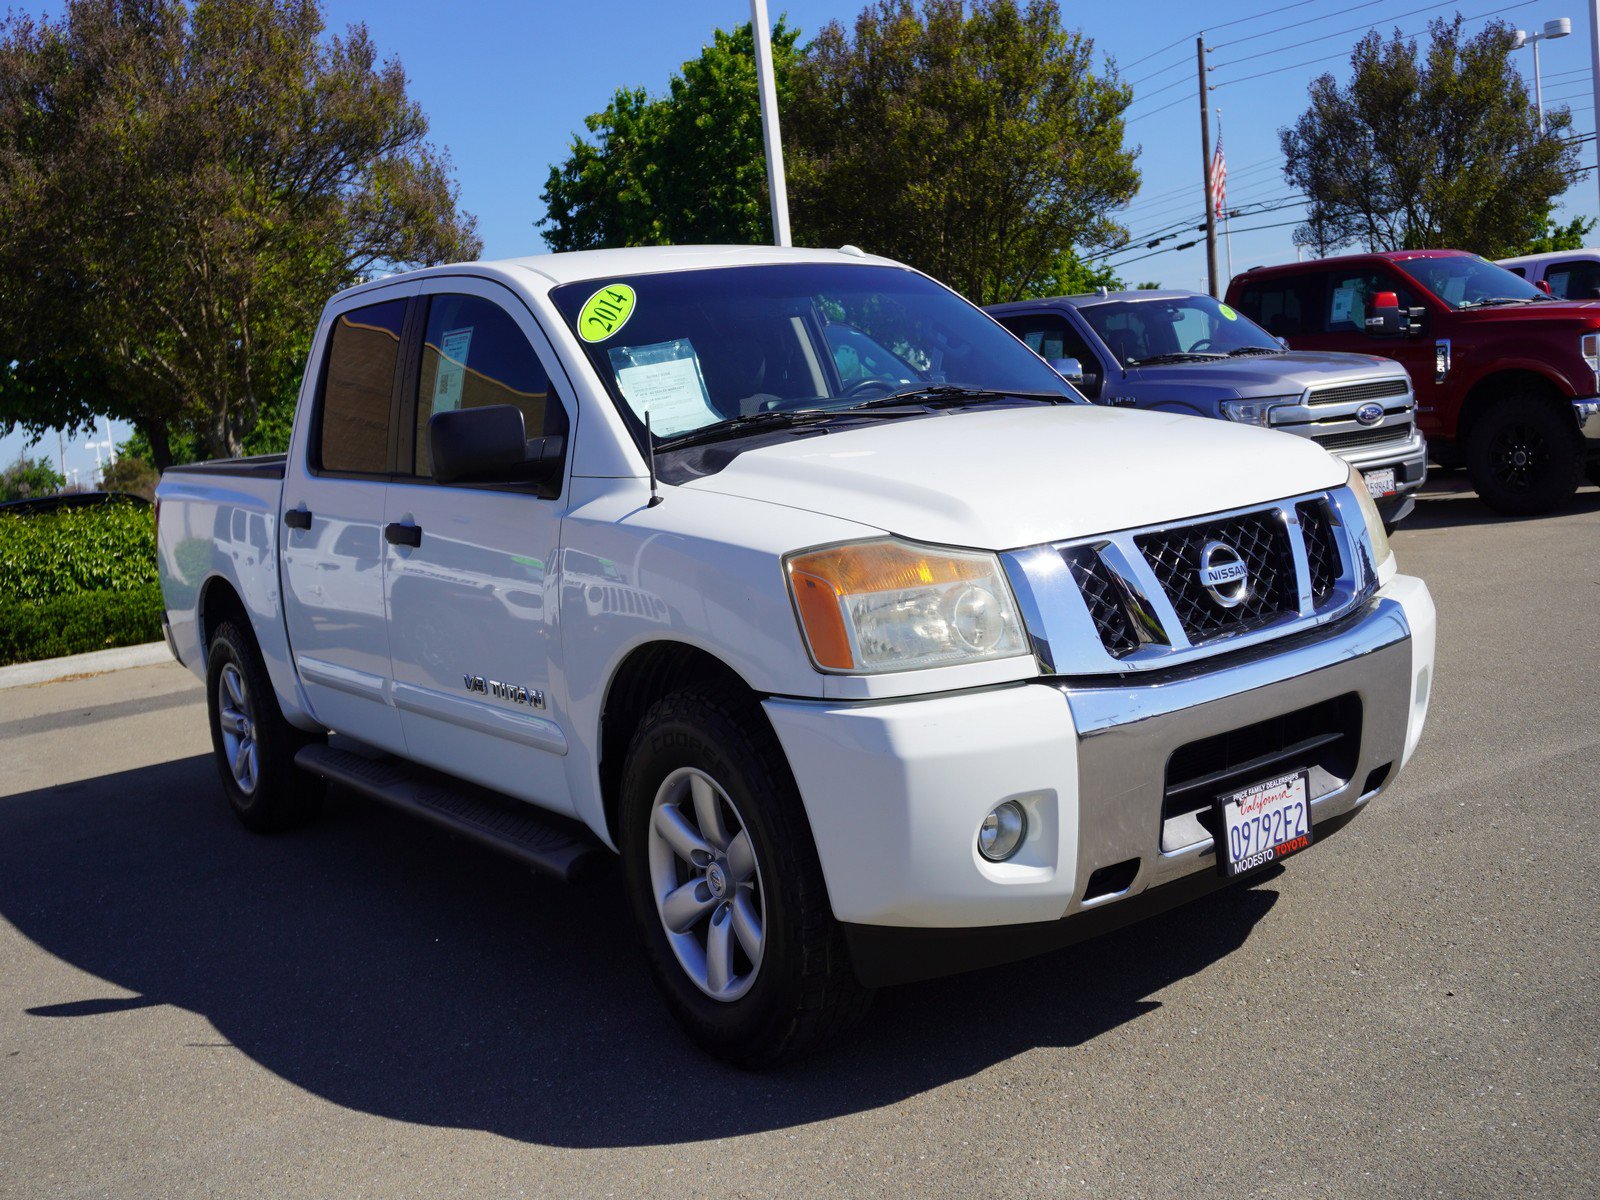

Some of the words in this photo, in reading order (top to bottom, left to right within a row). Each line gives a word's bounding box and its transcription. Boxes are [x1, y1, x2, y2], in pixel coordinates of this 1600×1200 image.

[588, 289, 628, 333] 2014
[1208, 564, 1247, 582] NISSAN
[463, 673, 488, 696] V8
[489, 680, 546, 710] TITAN
[1240, 789, 1293, 815] California
[1248, 784, 1266, 795] FAMILY
[1231, 802, 1305, 861] 09792F2
[1234, 848, 1274, 875] MODESTO
[1275, 836, 1308, 857] TOYOTA
